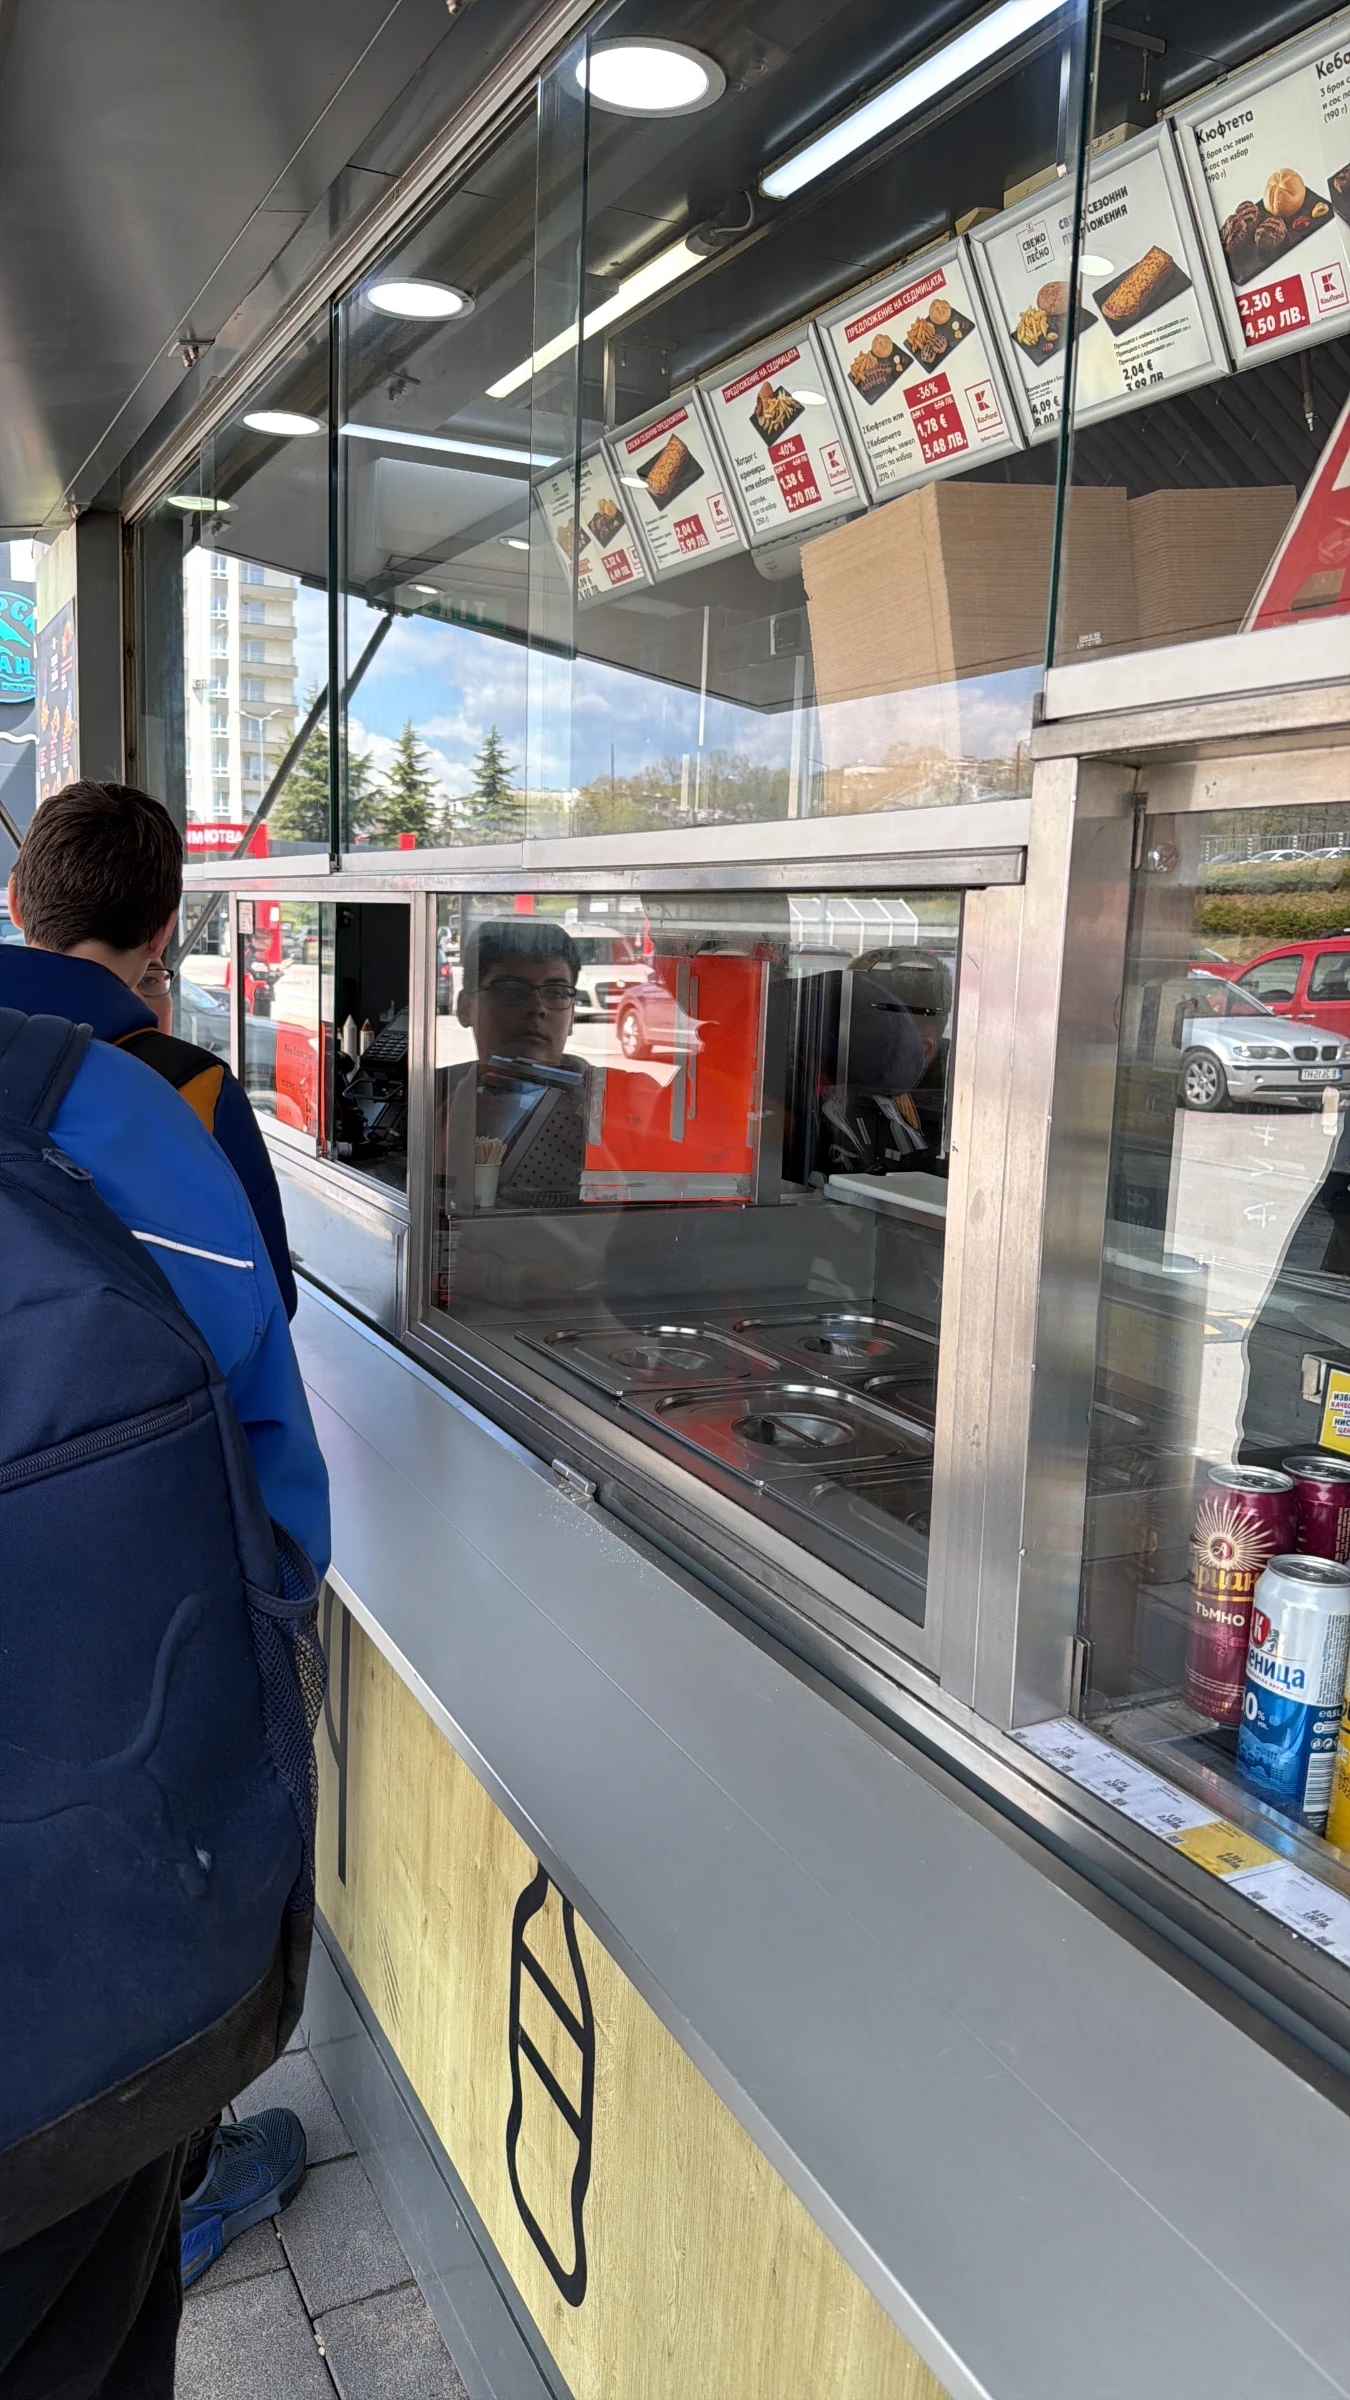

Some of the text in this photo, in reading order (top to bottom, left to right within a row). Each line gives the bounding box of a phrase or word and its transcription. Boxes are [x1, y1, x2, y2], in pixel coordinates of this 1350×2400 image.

[1315, 52, 1350, 80] Кеба
[1319, 87, 1326, 98] 3
[1327, 79, 1345, 94] броя
[1322, 102, 1328, 110] и
[1329, 95, 1342, 107] сос
[1195, 110, 1254, 146] Кюфтета
[1206, 146, 1222, 161] броя
[1223, 140, 1234, 153] със
[1234, 131, 1254, 147] земел
[1209, 157, 1220, 171] сос
[1220, 156, 1229, 166] по
[1230, 147, 1249, 161] избор
[1206, 171, 1220, 184] 190
[1087, 185, 1129, 215] СЕЗОННИ
[1021, 232, 1046, 251] СВЕЖО
[1026, 246, 1050, 266] ЛЕСНО
[847, 273, 943, 339] ПРЕДЛОЖЕНИЕ НА СЕДМИЦАТА
[1238, 286, 1285, 316] 2,30 €
[1320, 290, 1345, 305] Kaufland
[1245, 306, 1306, 339] 4,50 ЛВ.
[759, 366, 769, 379] НА
[767, 348, 799, 374] СЕДМИЦАТА
[1122, 359, 1154, 381] 2,04 €
[916, 381, 938, 400] -36%
[1032, 399, 1051, 415] 4,09
[1053, 395, 1060, 407] €
[866, 415, 892, 433] Кюфтета
[892, 412, 905, 422] или
[917, 413, 948, 438] 1,78 €
[777, 441, 797, 457] -40%
[870, 429, 902, 448] Кебапчета
[898, 437, 916, 450] земел
[922, 438, 946, 459] 3,48
[947, 431, 967, 450] ЛВ.
[896, 452, 913, 465] избор
[780, 469, 805, 492] 1,38 €
[786, 491, 805, 510] 2,70
[804, 486, 820, 501] ЛВ.
[675, 522, 692, 539] 2,04
[690, 520, 698, 533] €
[680, 537, 697, 554] 3,99
[1195, 1600, 1246, 1628] ТЪМНО
[1248, 1648, 1305, 1690] еница
